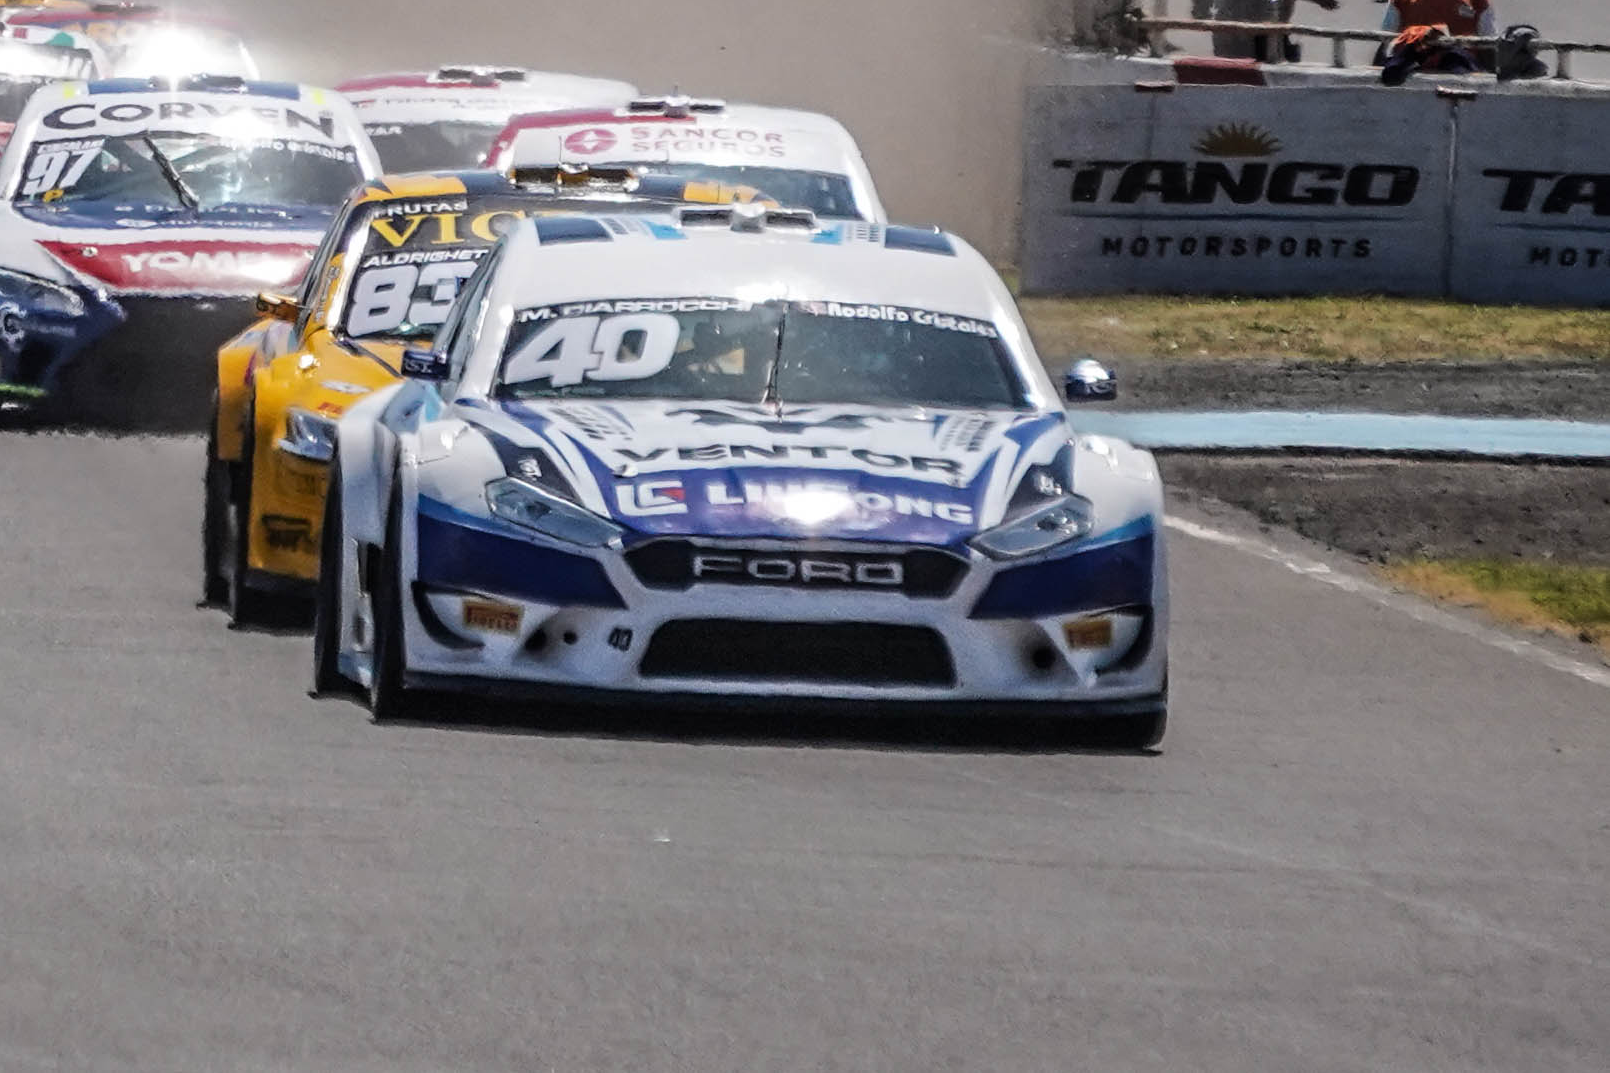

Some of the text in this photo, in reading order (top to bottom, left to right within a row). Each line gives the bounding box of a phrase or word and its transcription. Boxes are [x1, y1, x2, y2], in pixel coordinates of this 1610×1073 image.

[630, 127, 784, 143] SANCOR
[631, 140, 786, 158] SEGUROS
[23, 147, 103, 196] 97
[1052, 158, 1421, 208] TANGO
[374, 200, 469, 219] FRUTAS
[1100, 235, 1373, 260] MOTORSPORTS
[346, 261, 479, 338] 83
[827, 302, 909, 323] Rodolfo
[504, 313, 681, 389] 40
[613, 443, 965, 475] VENTOR
[692, 554, 904, 585] FORD
